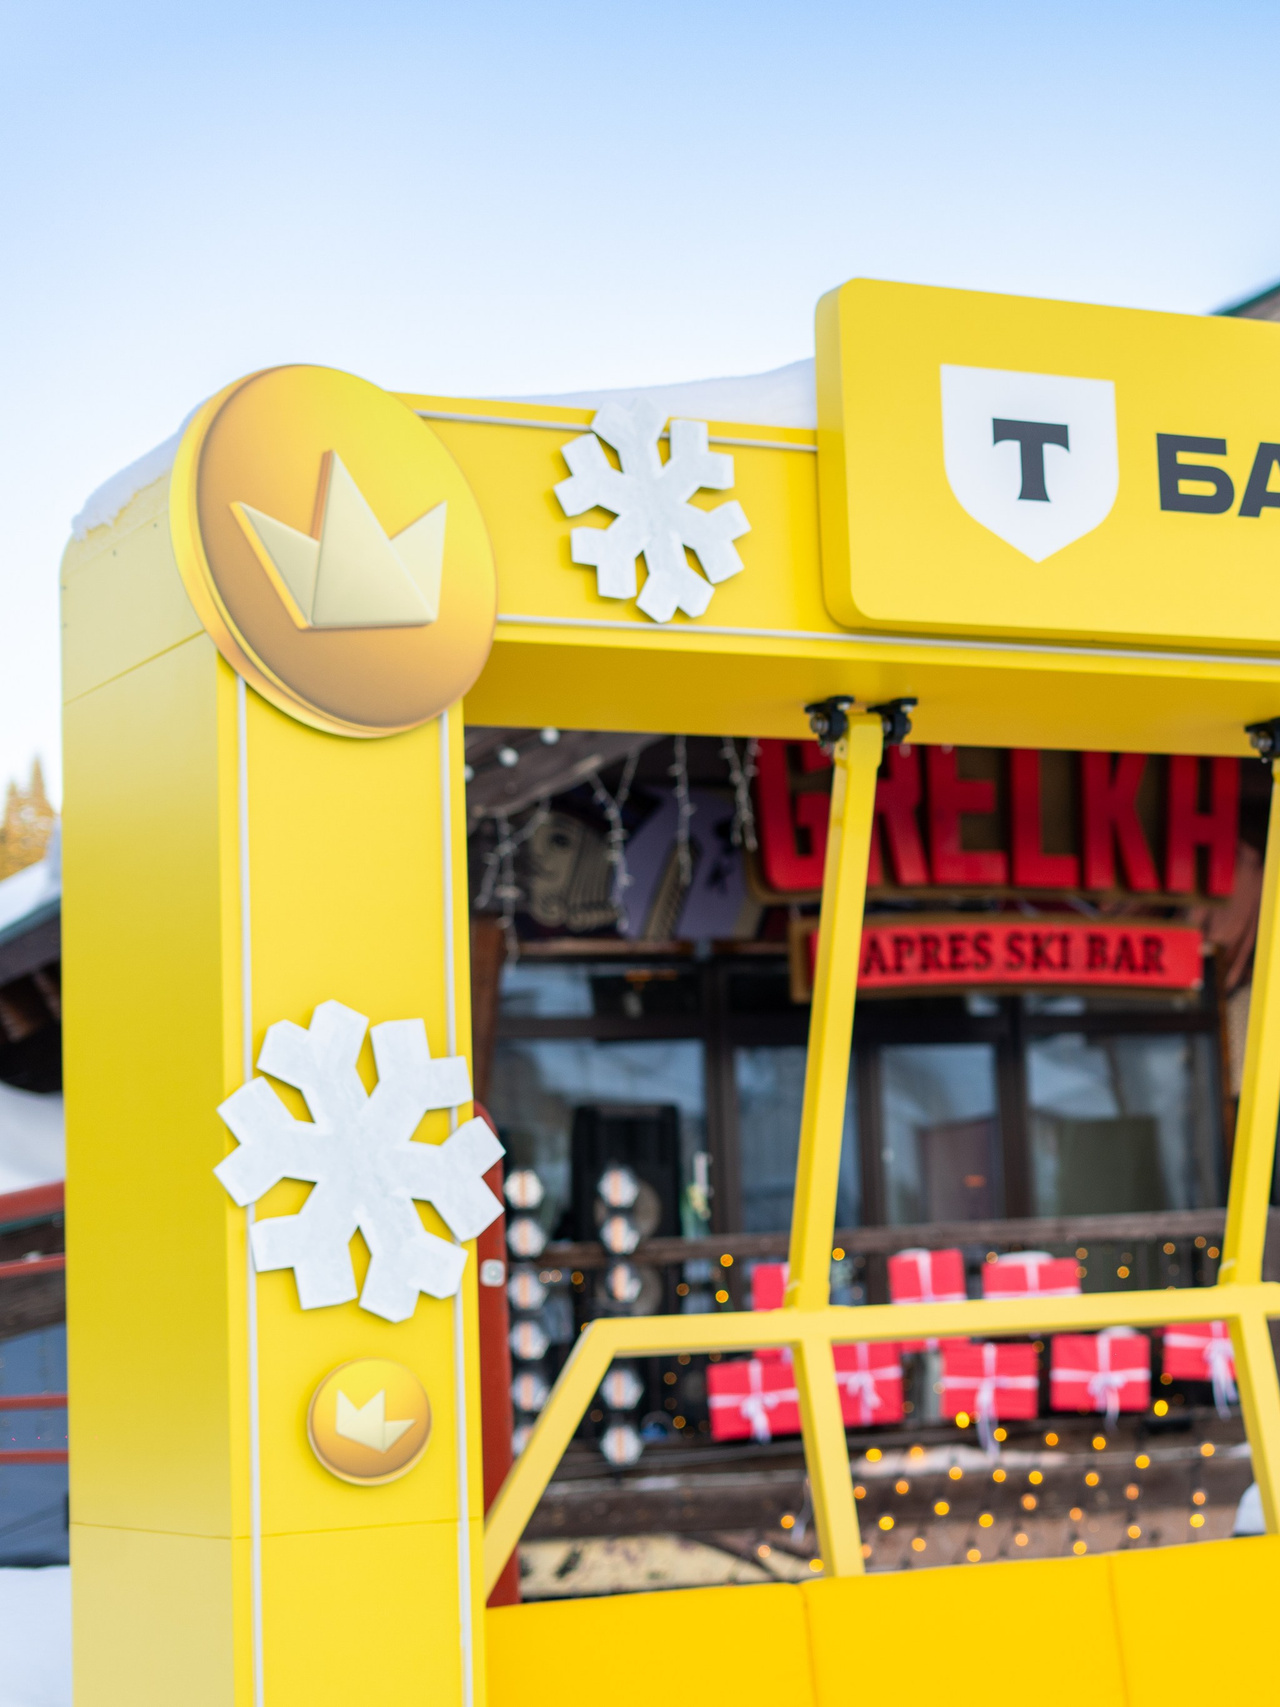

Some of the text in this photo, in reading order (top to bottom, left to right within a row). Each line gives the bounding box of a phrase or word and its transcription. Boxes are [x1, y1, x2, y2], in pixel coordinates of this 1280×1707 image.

[992, 417, 1070, 503] Т
[862, 931, 1165, 976] APRES SKI BAR
